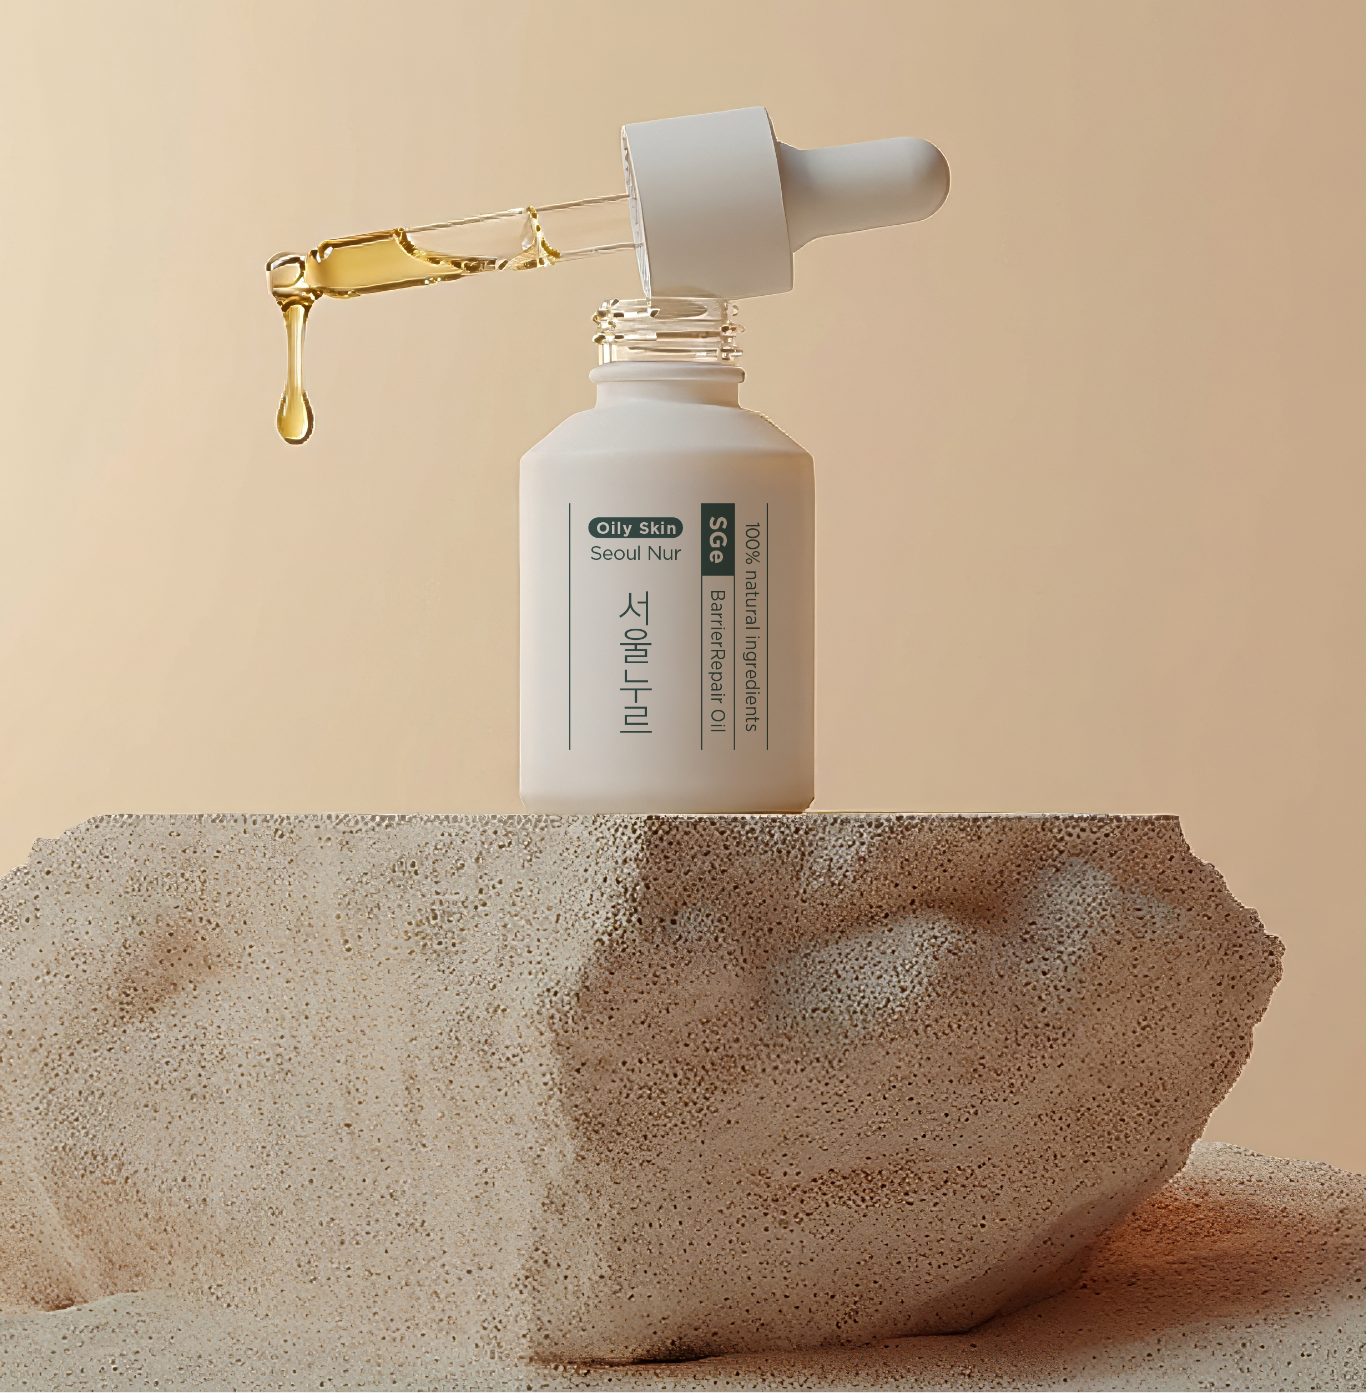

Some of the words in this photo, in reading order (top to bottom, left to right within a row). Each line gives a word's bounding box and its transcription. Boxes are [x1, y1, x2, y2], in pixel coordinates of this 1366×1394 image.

[590, 545, 641, 561] Seoul
[648, 545, 682, 561] Nur
[596, 521, 633, 537] Oily
[639, 521, 677, 535] Skin
[709, 516, 728, 564] SGe
[745, 522, 761, 565] 100%
[745, 570, 761, 630] natural
[619, 591, 653, 734] 서울누르
[708, 590, 726, 704] BarrierRepair
[742, 636, 761, 732] ingredients
[710, 709, 726, 732] Oil
